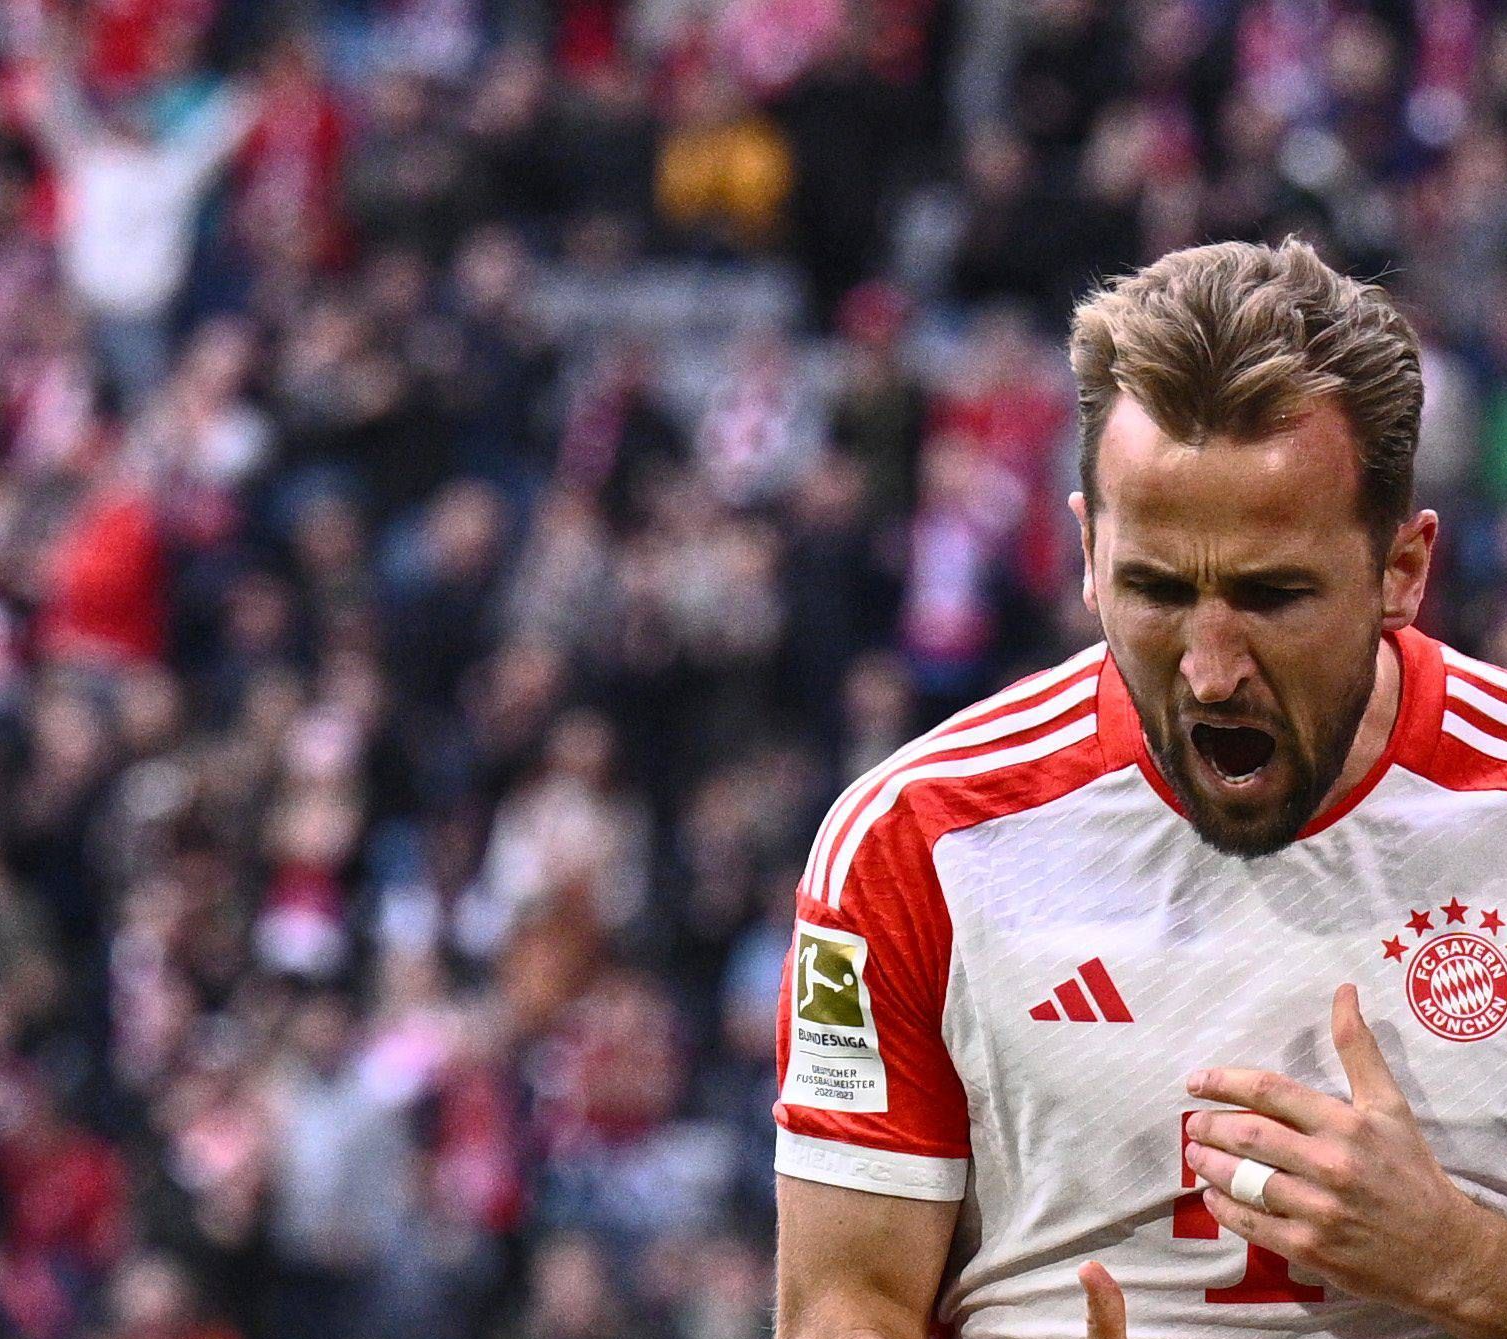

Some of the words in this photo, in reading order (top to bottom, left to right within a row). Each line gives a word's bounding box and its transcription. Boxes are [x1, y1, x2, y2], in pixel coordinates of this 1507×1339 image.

[1416, 955, 1437, 981] FC
[1434, 940, 1506, 979] BAYERN
[798, 1027, 869, 1049] BUNDESLIGA
[796, 1073, 876, 1089] FUSSBALLMEISTER
[814, 1086, 854, 1101] 2022/2023
